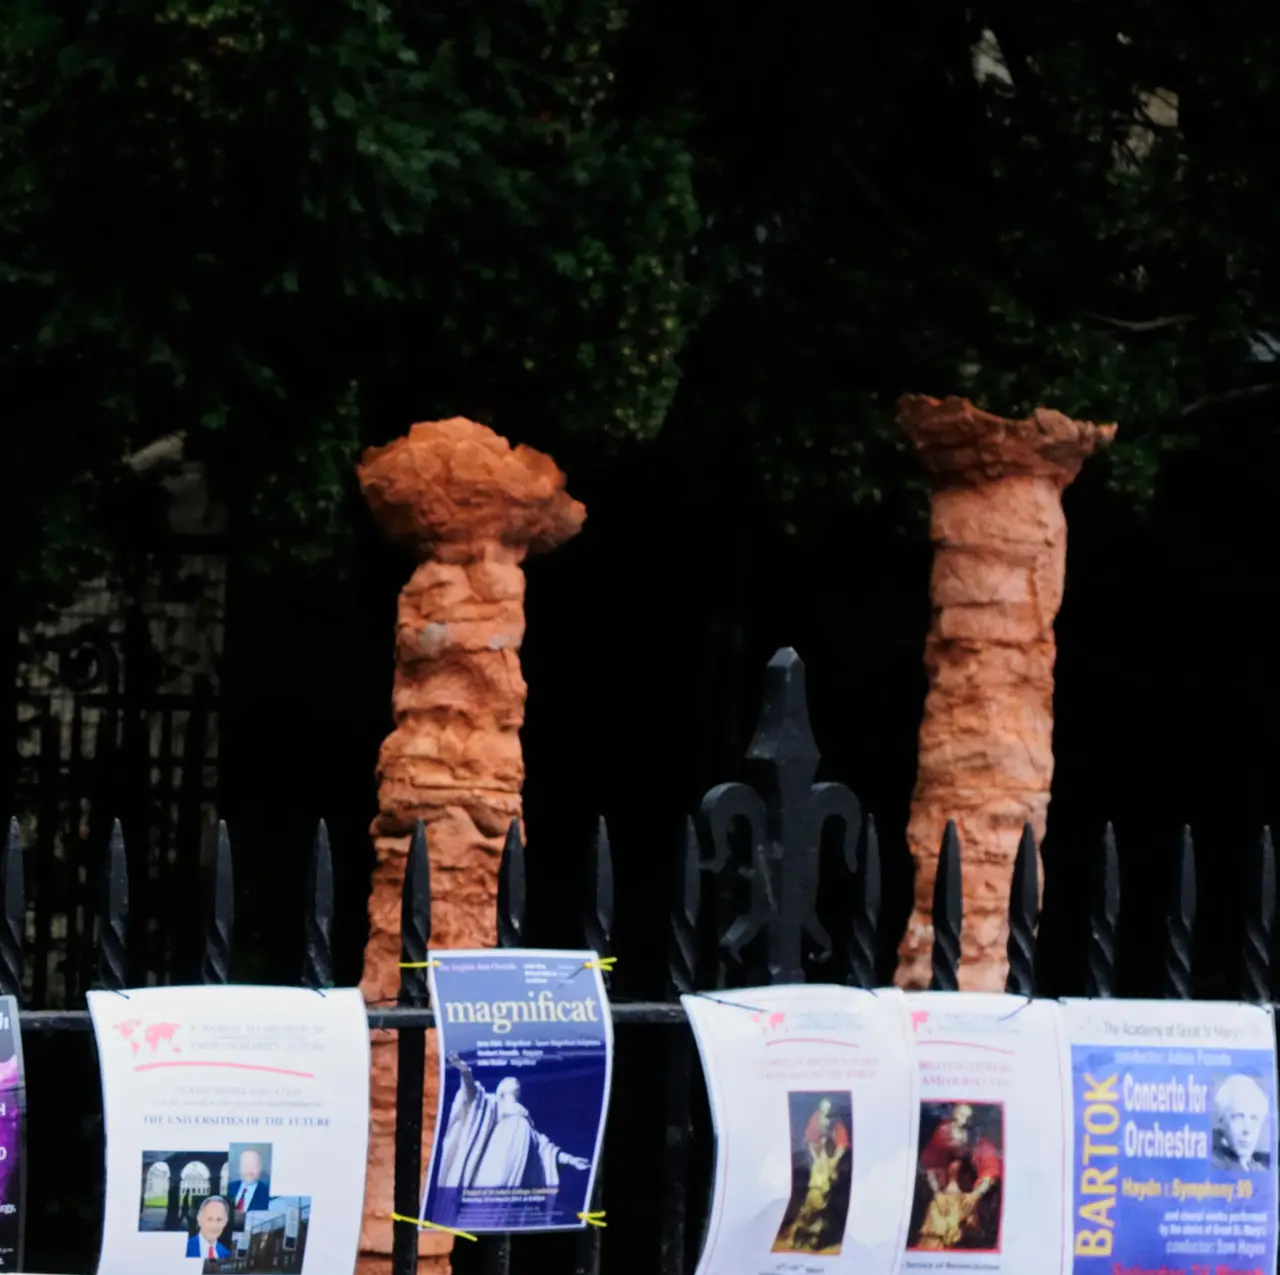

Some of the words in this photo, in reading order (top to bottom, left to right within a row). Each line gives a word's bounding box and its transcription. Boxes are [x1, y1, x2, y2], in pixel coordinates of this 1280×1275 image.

[444, 989, 601, 1034] magnificat
[1124, 1072, 1186, 1113] Concerto
[1188, 1074, 1208, 1113] for
[142, 1115, 162, 1127] THE
[1124, 1120, 1208, 1159] Orchestra
[1074, 1072, 1121, 1257] BARTOK
